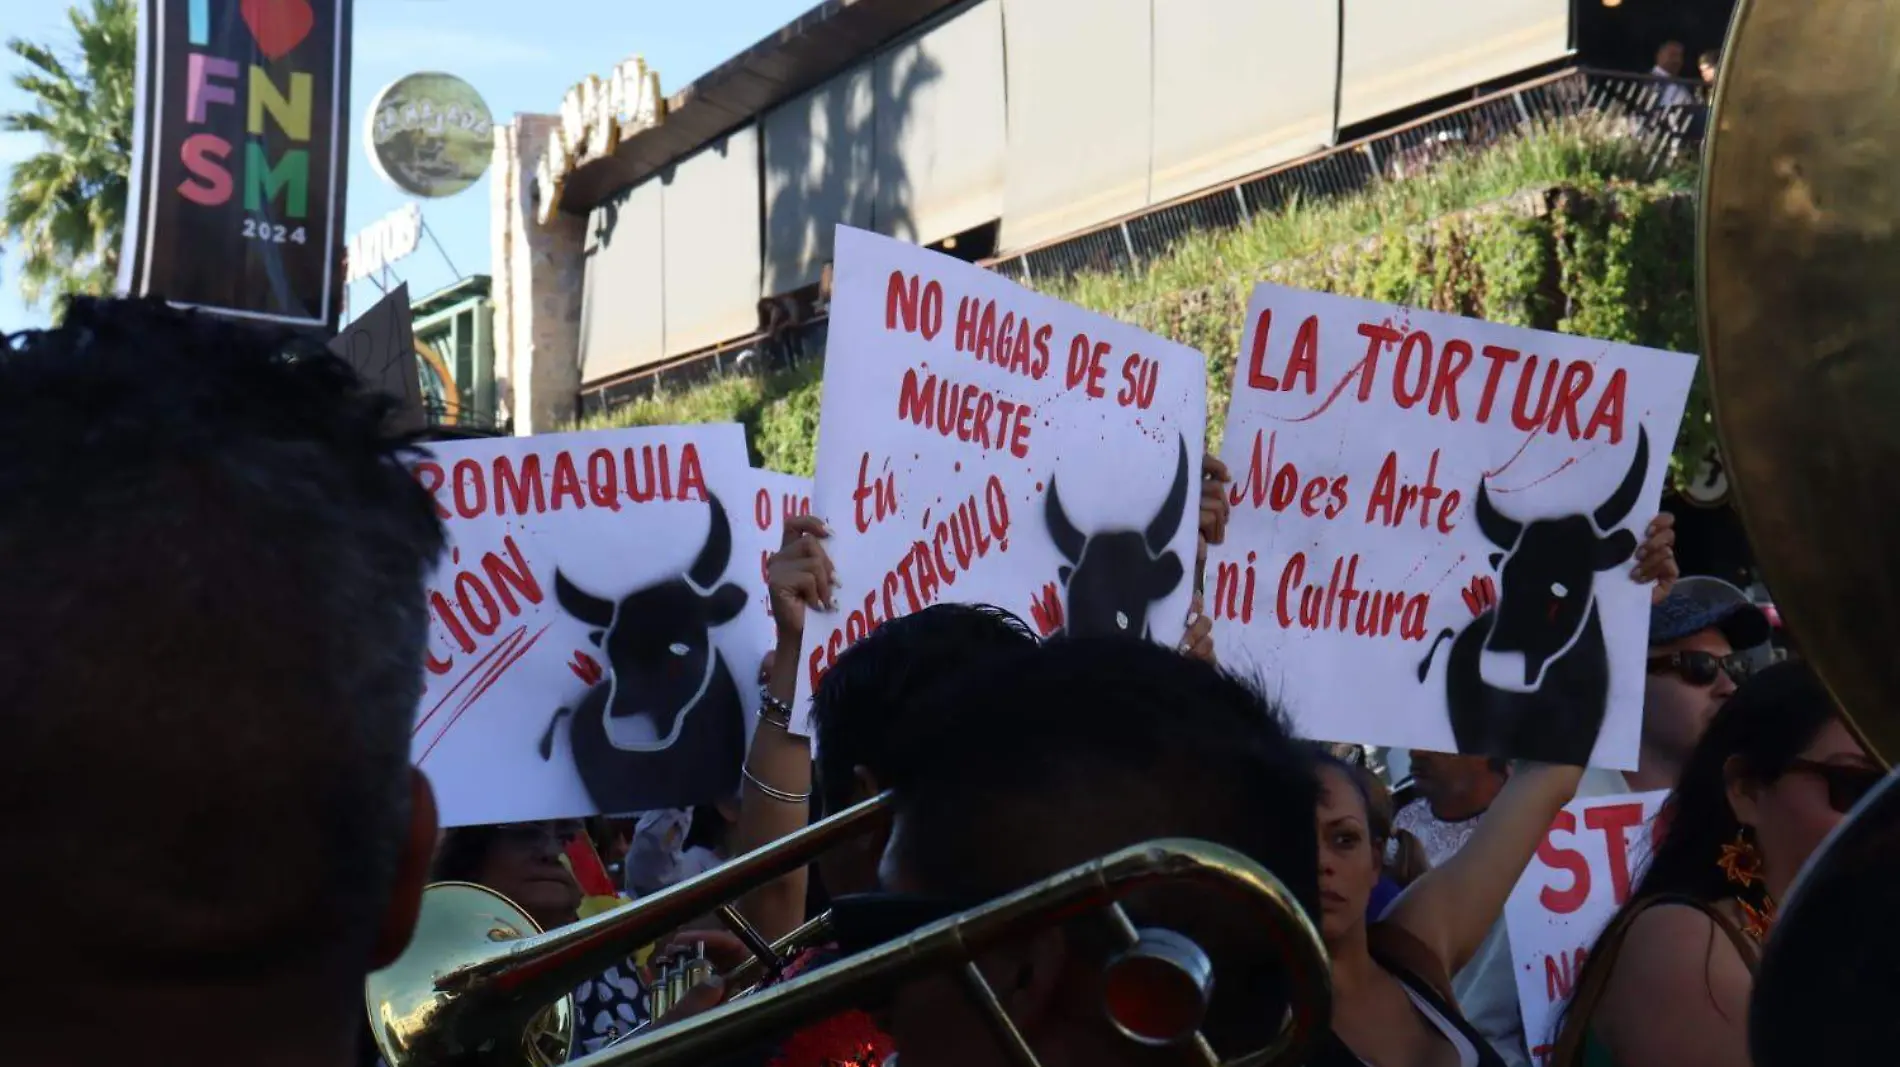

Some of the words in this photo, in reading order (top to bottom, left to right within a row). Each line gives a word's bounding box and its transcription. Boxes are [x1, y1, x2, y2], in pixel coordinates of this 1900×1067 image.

[241, 219, 307, 245] 2024
[885, 270, 943, 341] NO
[955, 295, 1054, 381] HAGAS
[1067, 333, 1113, 399] DE
[1118, 353, 1160, 410] SU
[1248, 308, 1318, 395] LA
[1357, 322, 1629, 446] TORTURA
[898, 367, 1033, 460] MUERTE
[852, 451, 899, 534] tú
[1364, 447, 1461, 534] Arte
[1214, 551, 1256, 624] ni
[1276, 551, 1431, 643] Cultura
